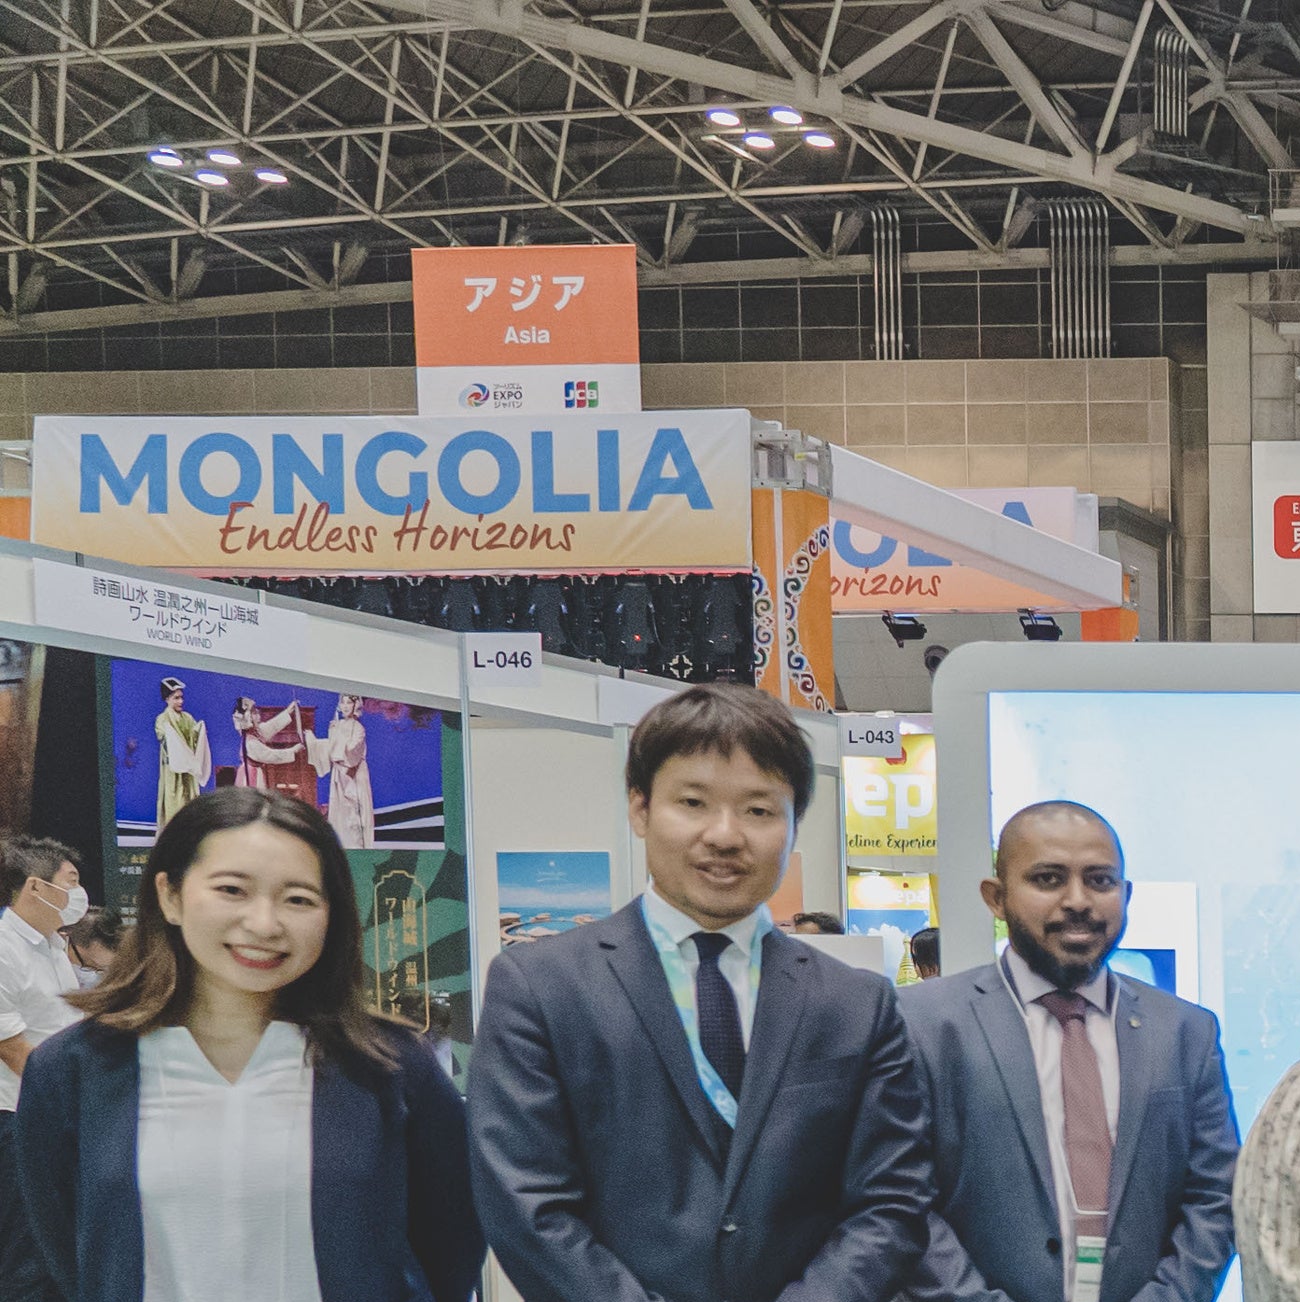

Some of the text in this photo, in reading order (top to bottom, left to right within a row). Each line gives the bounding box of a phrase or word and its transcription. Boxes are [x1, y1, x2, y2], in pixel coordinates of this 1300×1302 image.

[464, 275, 585, 312] アジア
[504, 325, 551, 344] Asia
[493, 390, 523, 400] EXPO
[80, 428, 714, 516] MONGOLIA
[219, 498, 576, 555] Endless Horizons
[830, 566, 941, 597] orizons
[147, 627, 212, 649] WORLD WIND
[473, 650, 532, 668] L-046
[849, 730, 895, 744] L-043
[846, 833, 881, 848] etime
